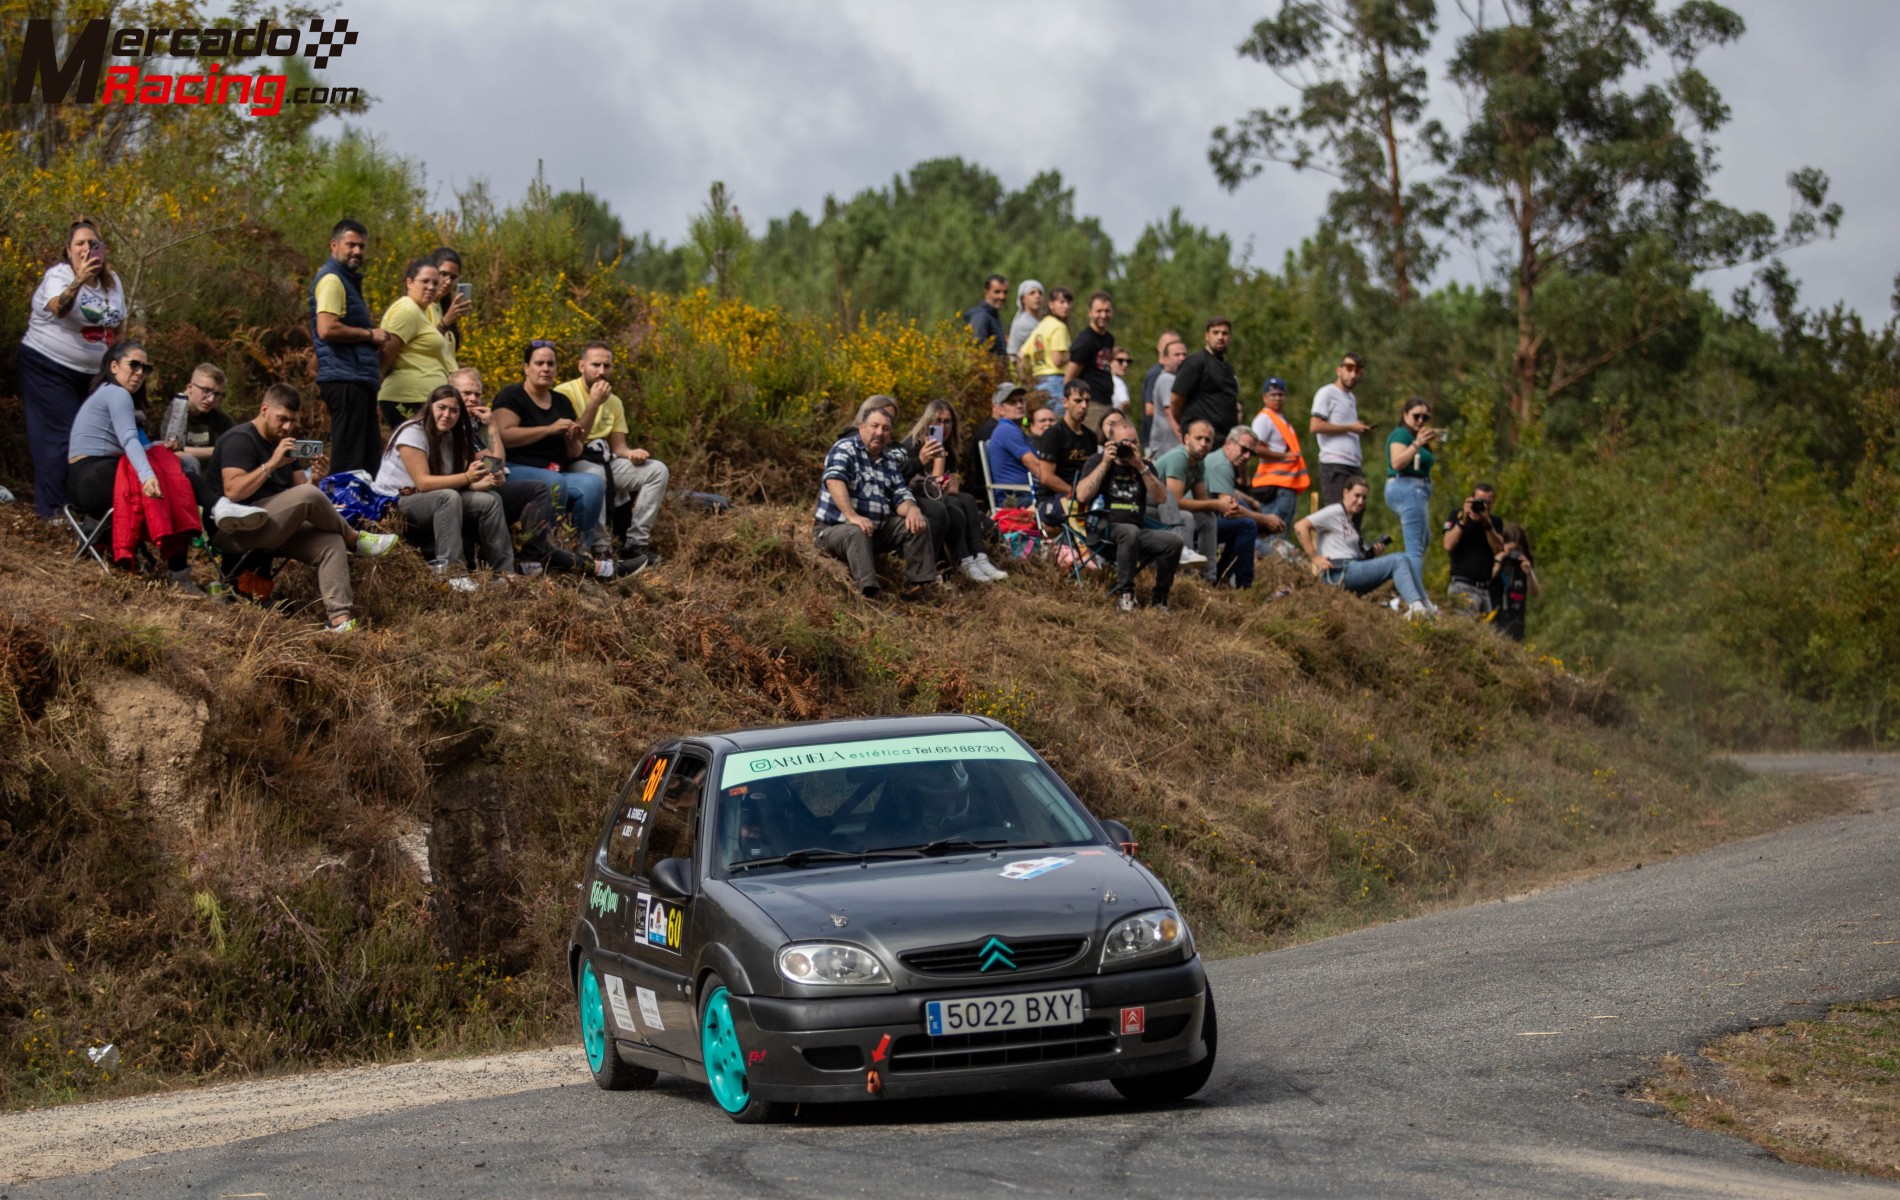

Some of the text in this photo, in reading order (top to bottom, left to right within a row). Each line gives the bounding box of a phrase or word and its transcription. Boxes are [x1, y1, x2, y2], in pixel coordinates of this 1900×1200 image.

[642, 758, 667, 802] 60
[668, 907, 682, 949] 60
[933, 1021, 938, 1029] E
[947, 993, 1074, 1029] 5022 BXY
